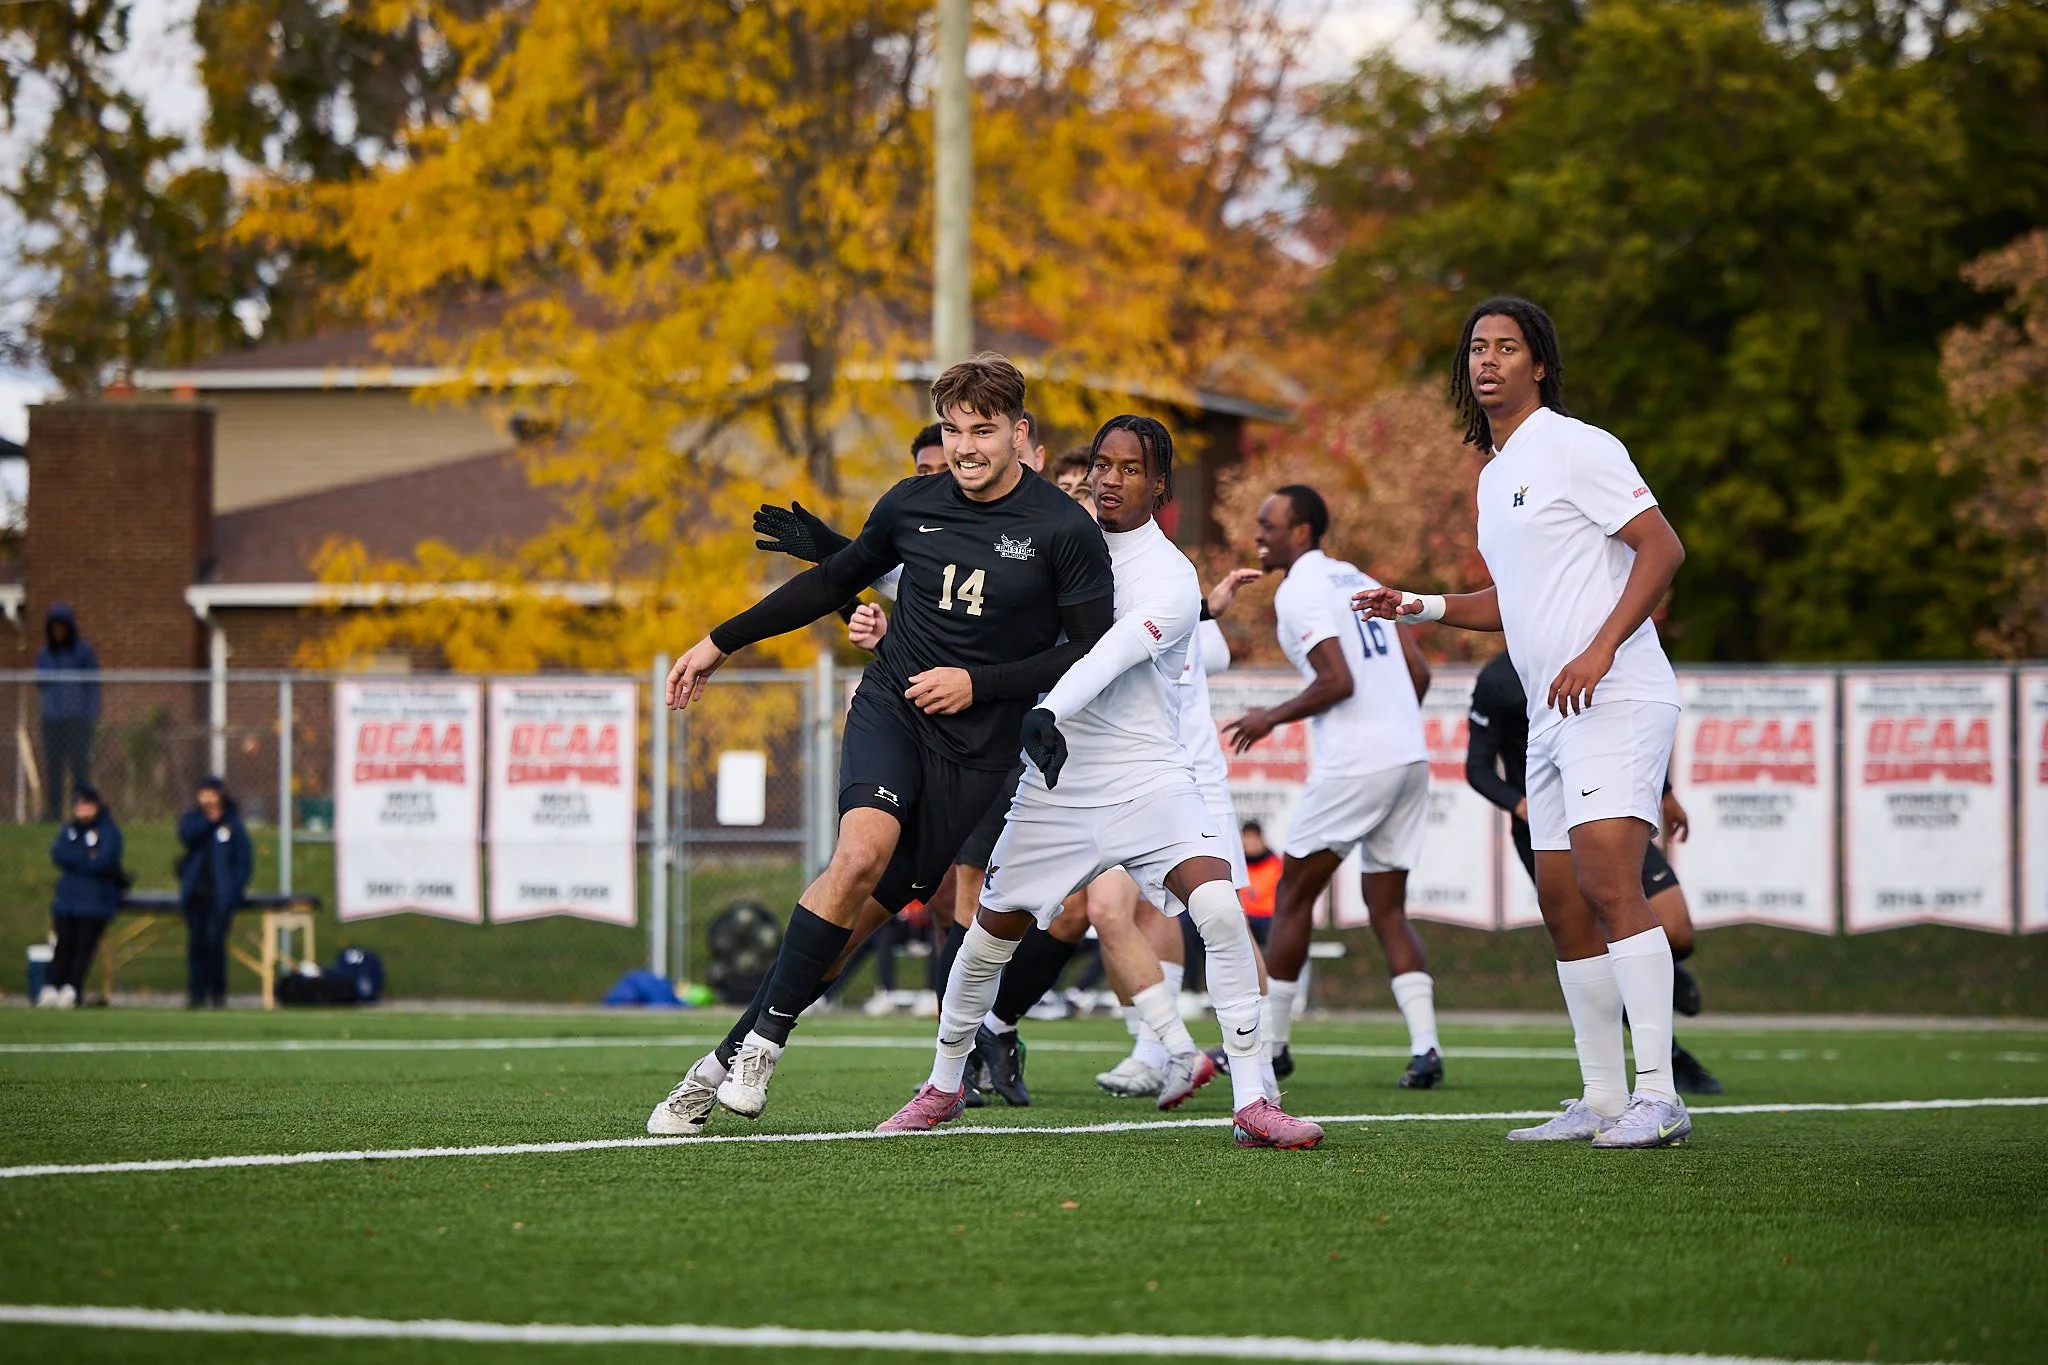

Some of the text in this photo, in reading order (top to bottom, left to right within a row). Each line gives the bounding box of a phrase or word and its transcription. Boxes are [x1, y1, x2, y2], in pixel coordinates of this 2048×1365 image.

[993, 542, 1036, 557] CONESTOGA
[1000, 551, 1028, 561] CONDORS
[938, 564, 987, 617] 14
[1143, 620, 1163, 642] OCAA
[357, 722, 464, 756] OCAA
[510, 723, 619, 757] OCAA
[1693, 717, 1816, 753] OCAA
[1865, 717, 1992, 754] OCAA
